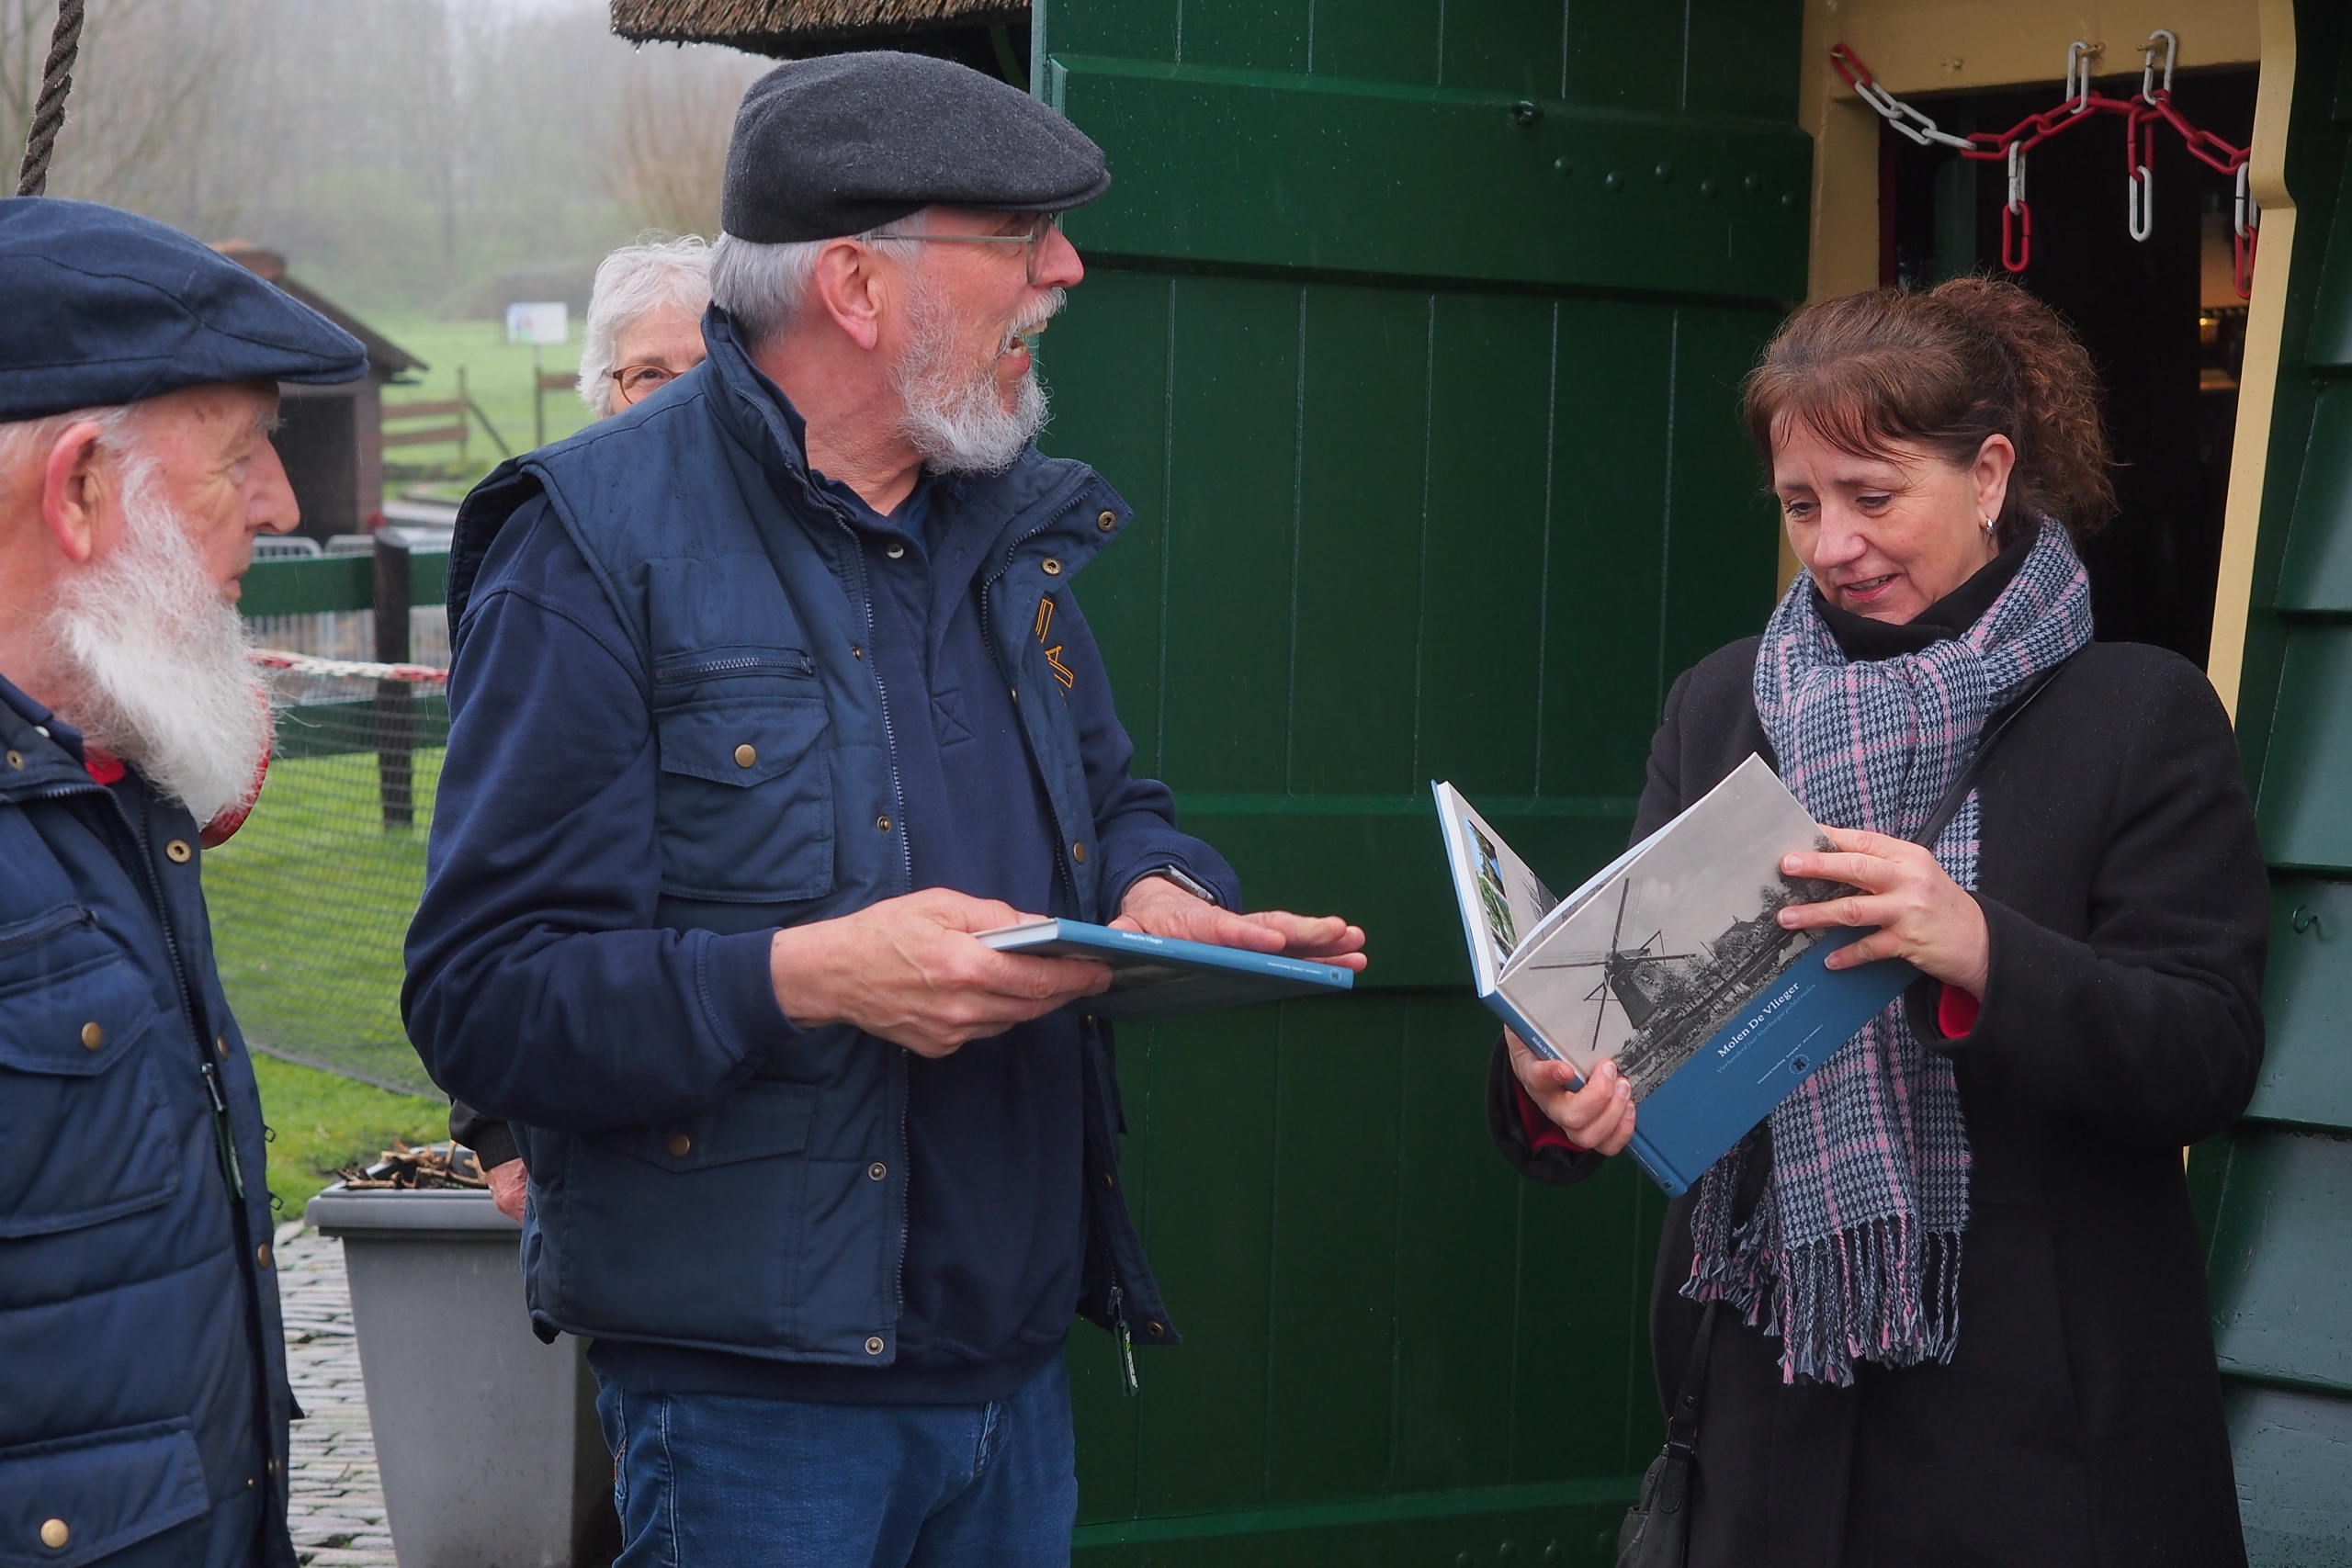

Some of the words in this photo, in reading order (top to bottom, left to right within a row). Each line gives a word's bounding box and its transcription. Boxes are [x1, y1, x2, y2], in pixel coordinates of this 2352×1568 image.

[1716, 1043, 1748, 1073] Vierhonderd
[1746, 1035, 1758, 1049] jaar
[1756, 1010, 1785, 1036] Voorburgse
[1784, 984, 1815, 1014] poldermolen
[1717, 1028, 1750, 1057] Molen
[1747, 1014, 1764, 1030] De
[1762, 983, 1799, 1013] Vlieger
